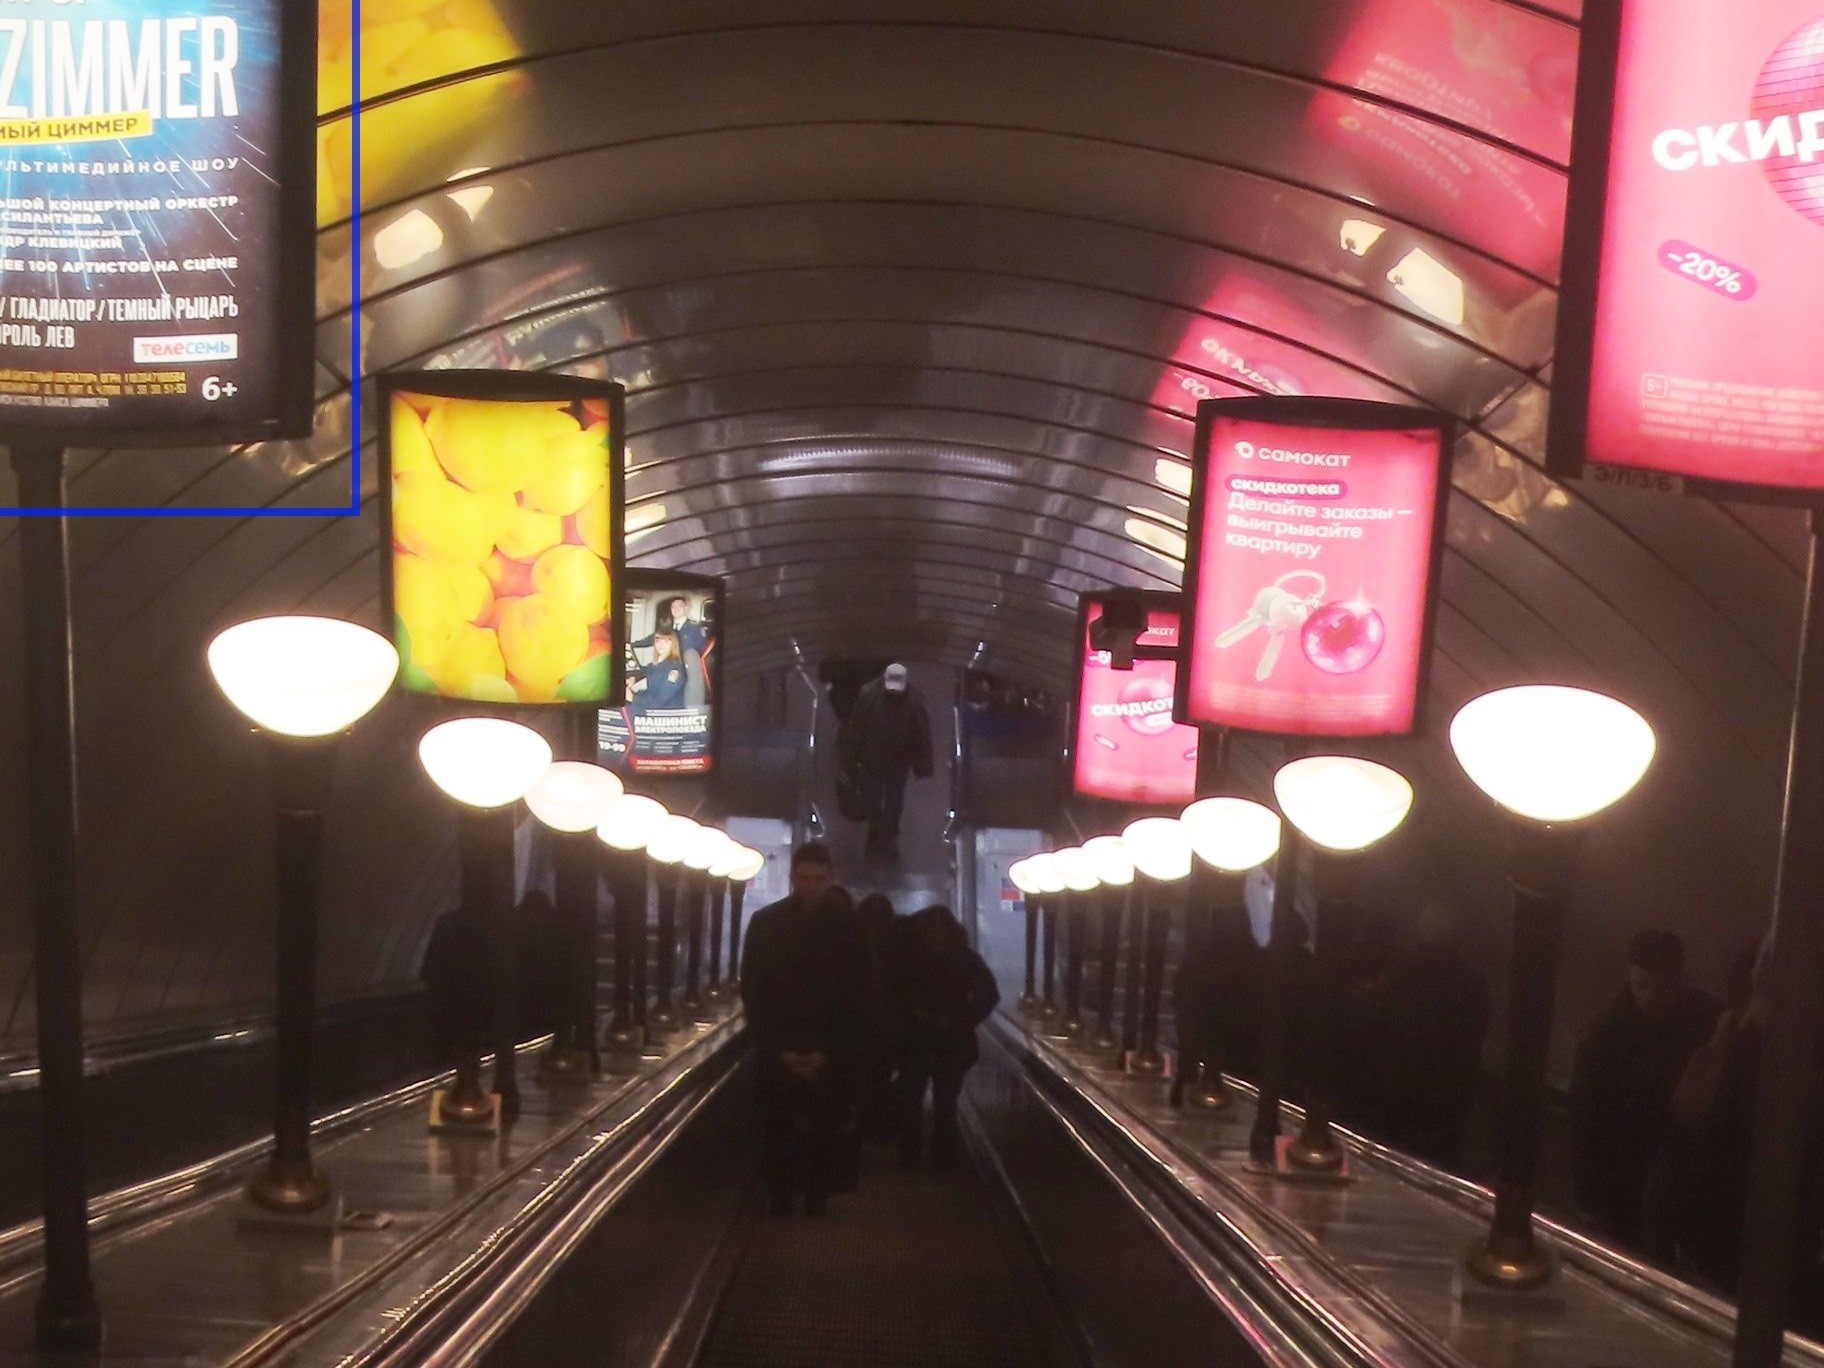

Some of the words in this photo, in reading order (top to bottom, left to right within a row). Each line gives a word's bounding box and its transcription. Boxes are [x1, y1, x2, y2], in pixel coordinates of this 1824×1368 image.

[48, 117, 138, 138] ЦИММЕР
[191, 157, 239, 172] ШОУ
[49, 197, 161, 213] КОНЦЕРТНЫЙ
[165, 195, 239, 211] ОРКЕСТР
[28, 234, 124, 250] КЛЕВИЦКИЙ
[28, 258, 59, 273] 100
[62, 259, 151, 274] АРТИСТОВ
[154, 258, 179, 272] НА
[183, 256, 239, 272] СЦЕНЕ
[9, 296, 96, 322] ГЛАДИАТОР
[107, 295, 172, 321] ТЕМНЫЙ
[175, 294, 239, 321] РЫЦАРЬ
[45, 325, 75, 349] ЛЕВ
[201, 375, 238, 402] 6+
[1258, 447, 1351, 467] самокат
[1231, 478, 1340, 496] скидкотека
[1228, 491, 1316, 518] Делайте
[1321, 507, 1393, 520] заказы
[1227, 513, 1363, 539] выигрывайте
[1225, 532, 1321, 559] квартиру
[634, 715, 708, 727] МАШИНИСТ
